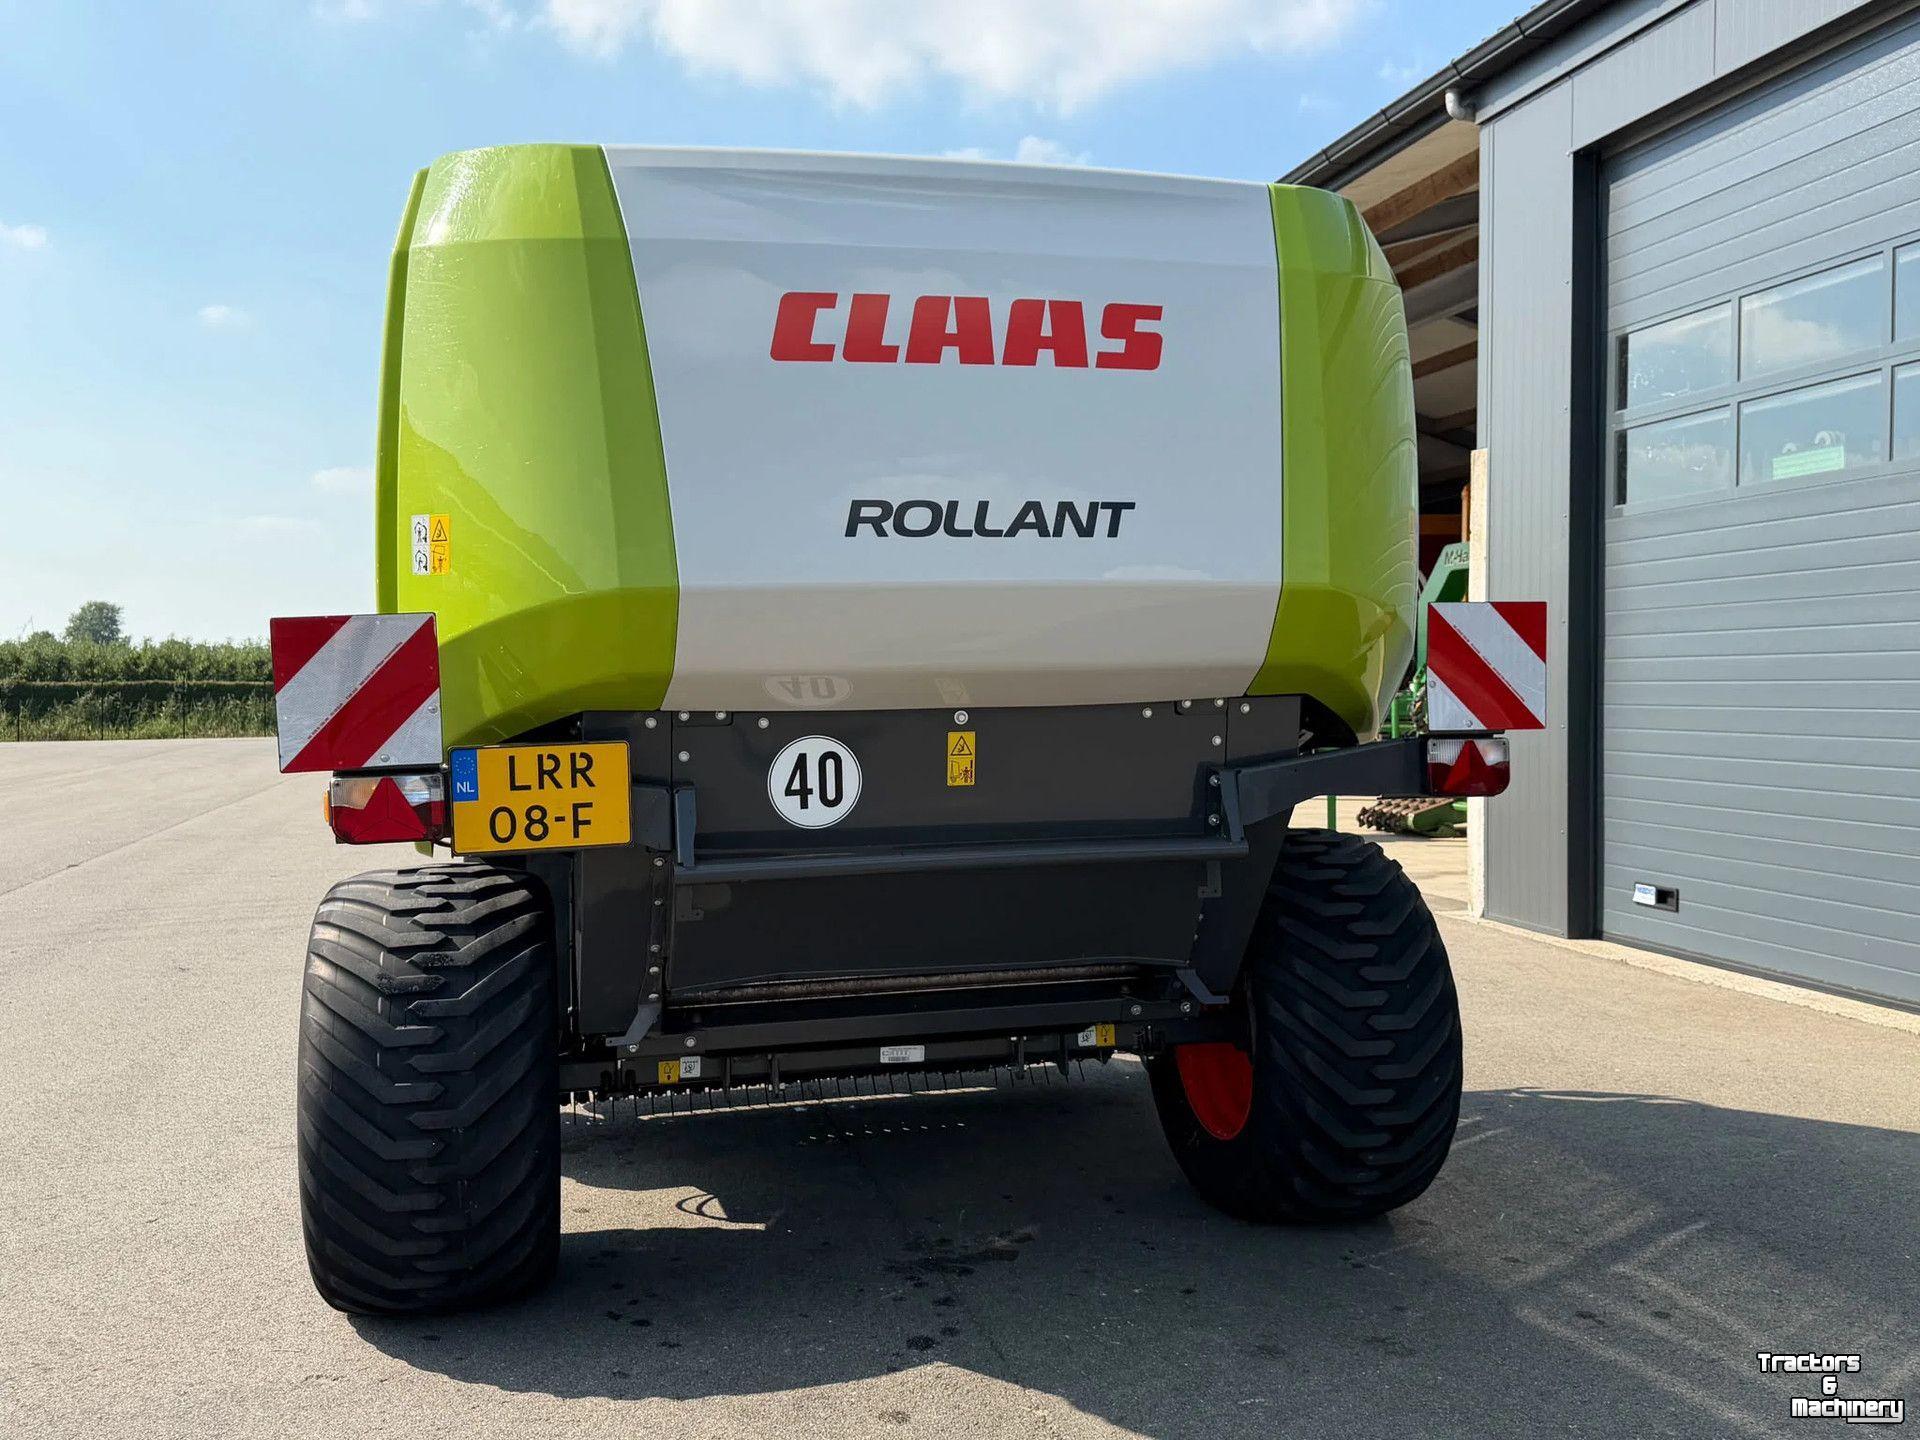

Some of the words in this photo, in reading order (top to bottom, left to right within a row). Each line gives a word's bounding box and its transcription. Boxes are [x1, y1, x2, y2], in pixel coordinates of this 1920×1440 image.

[770, 291, 1163, 371] CLAAS
[844, 499, 1136, 538] ROLLANT
[456, 781, 475, 793] NL
[508, 751, 596, 791] LRR
[784, 750, 843, 810] 40
[489, 802, 593, 843] 08-F
